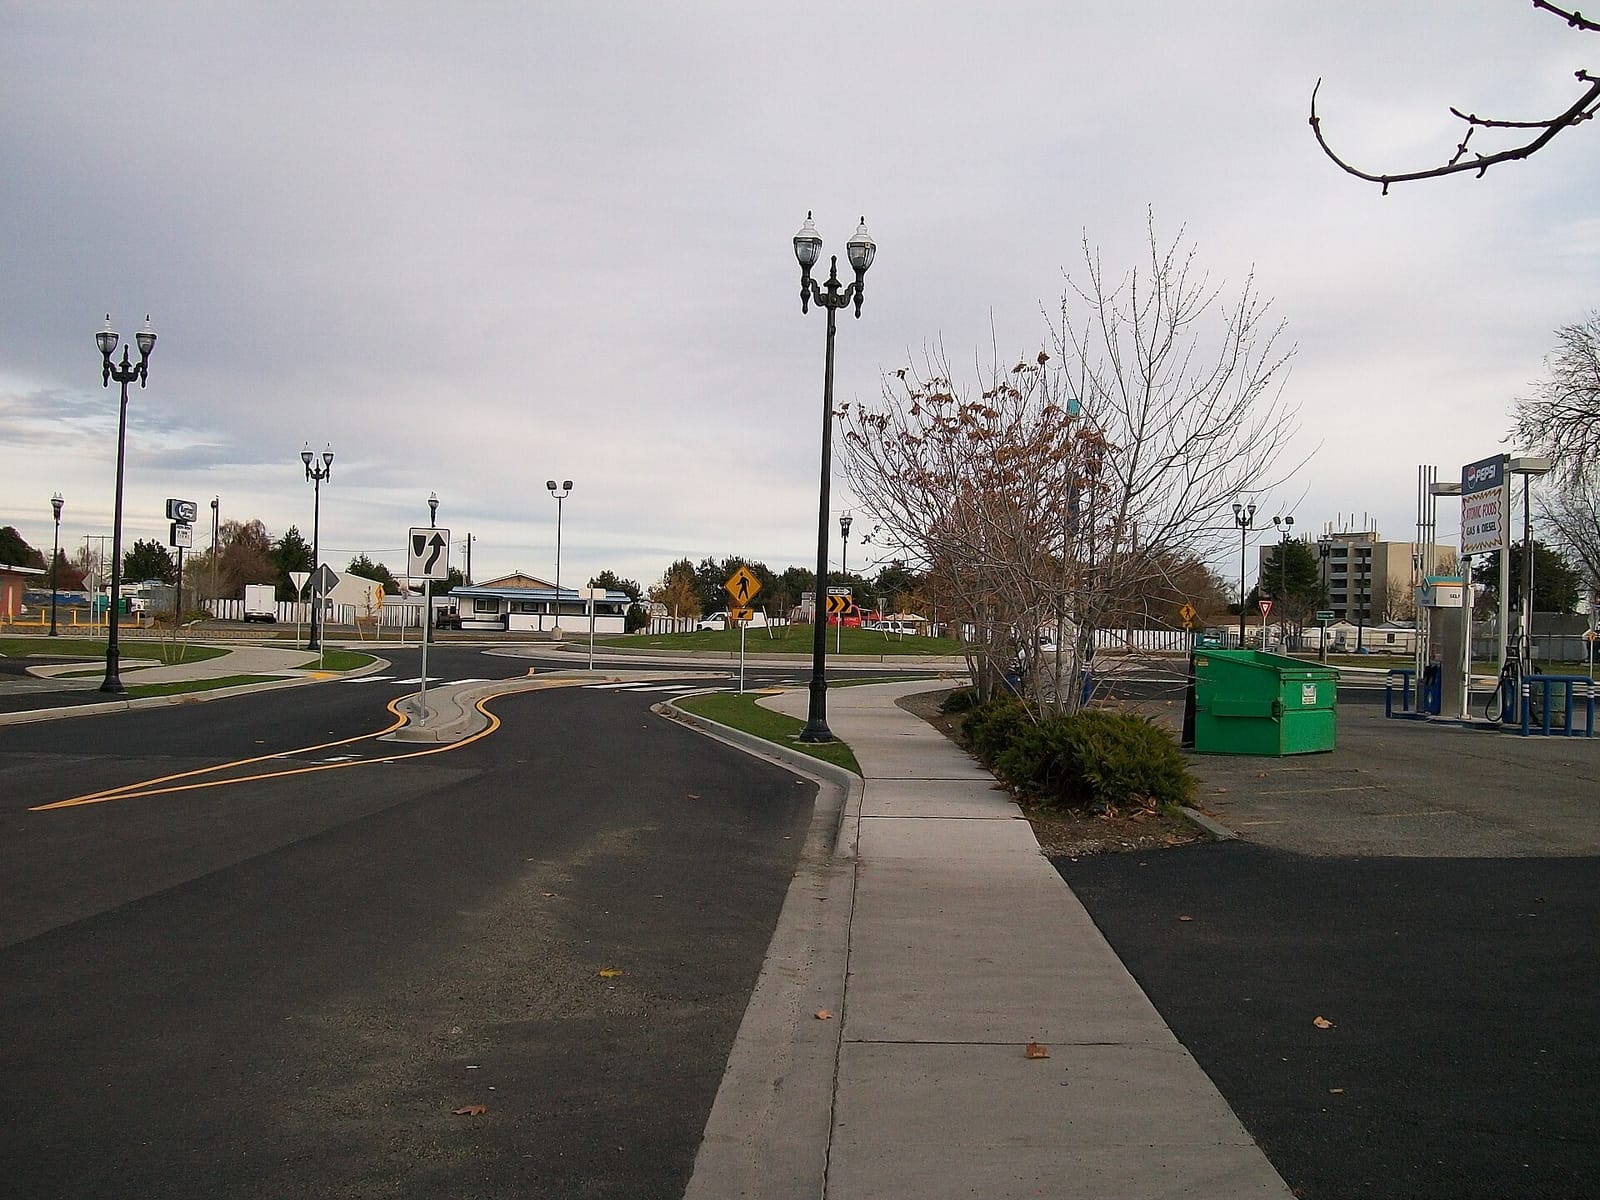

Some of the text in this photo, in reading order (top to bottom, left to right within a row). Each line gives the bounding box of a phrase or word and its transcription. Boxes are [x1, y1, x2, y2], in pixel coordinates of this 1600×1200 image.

[1475, 464, 1496, 482] PEPSI
[1482, 501, 1497, 518] FOODS
[1466, 525, 1475, 536] GAS
[1481, 521, 1497, 533] DIESEL
